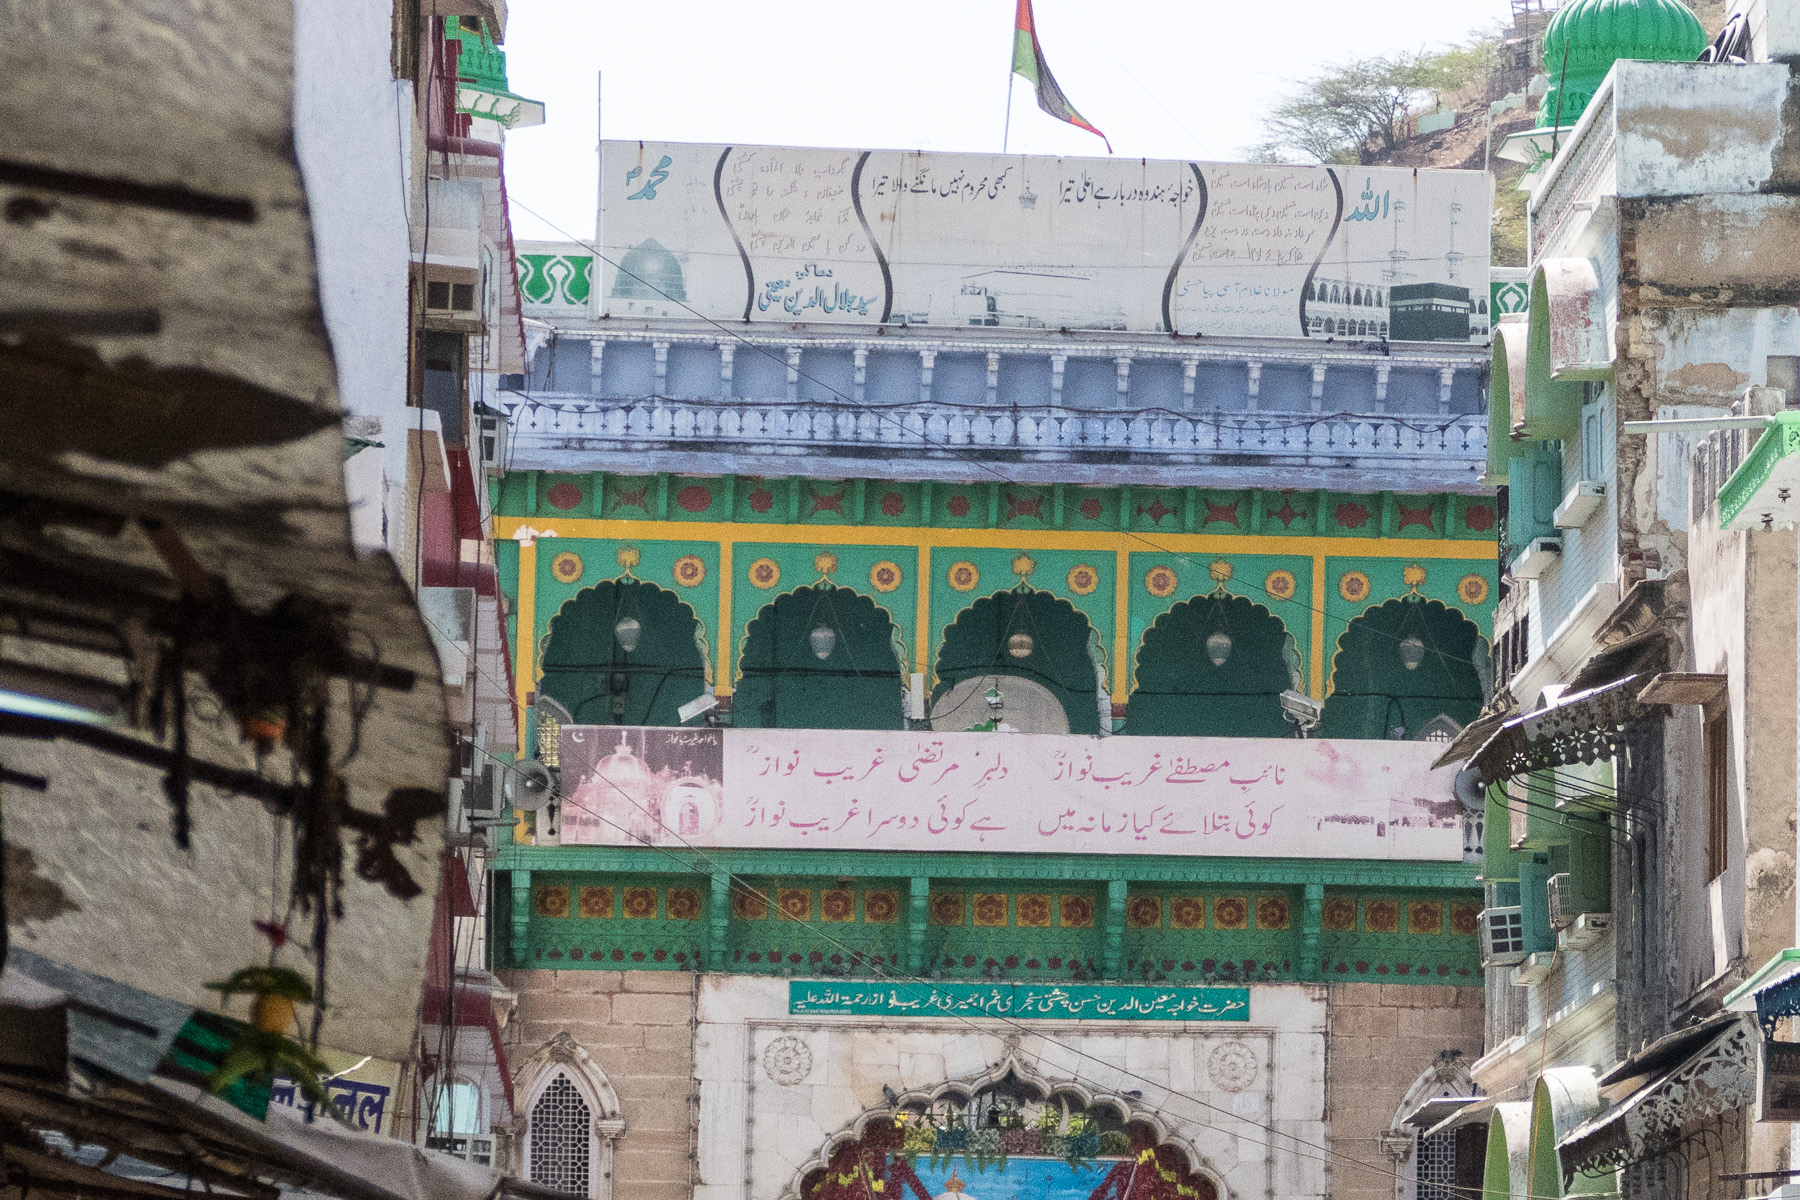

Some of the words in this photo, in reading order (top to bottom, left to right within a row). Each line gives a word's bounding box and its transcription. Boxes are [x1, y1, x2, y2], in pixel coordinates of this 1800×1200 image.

[872, 174, 890, 198] تیرا
[939, 169, 964, 197] نہیں
[961, 176, 988, 204] محروم
[988, 166, 1013, 199] کبھی
[1059, 178, 1076, 205] تیرا
[1113, 182, 1136, 207] دربار
[814, 748, 884, 785] غریب
[1091, 753, 1162, 790] غریب
[789, 798, 859, 835] غریب
[866, 808, 920, 839] دوسرا
[928, 795, 978, 835] کوئی
[969, 814, 1007, 842] ہے
[1038, 807, 1076, 836] میں
[1133, 804, 1167, 840] کیا
[1235, 801, 1285, 839] کوئی
[1097, 995, 1138, 1015] الدین
